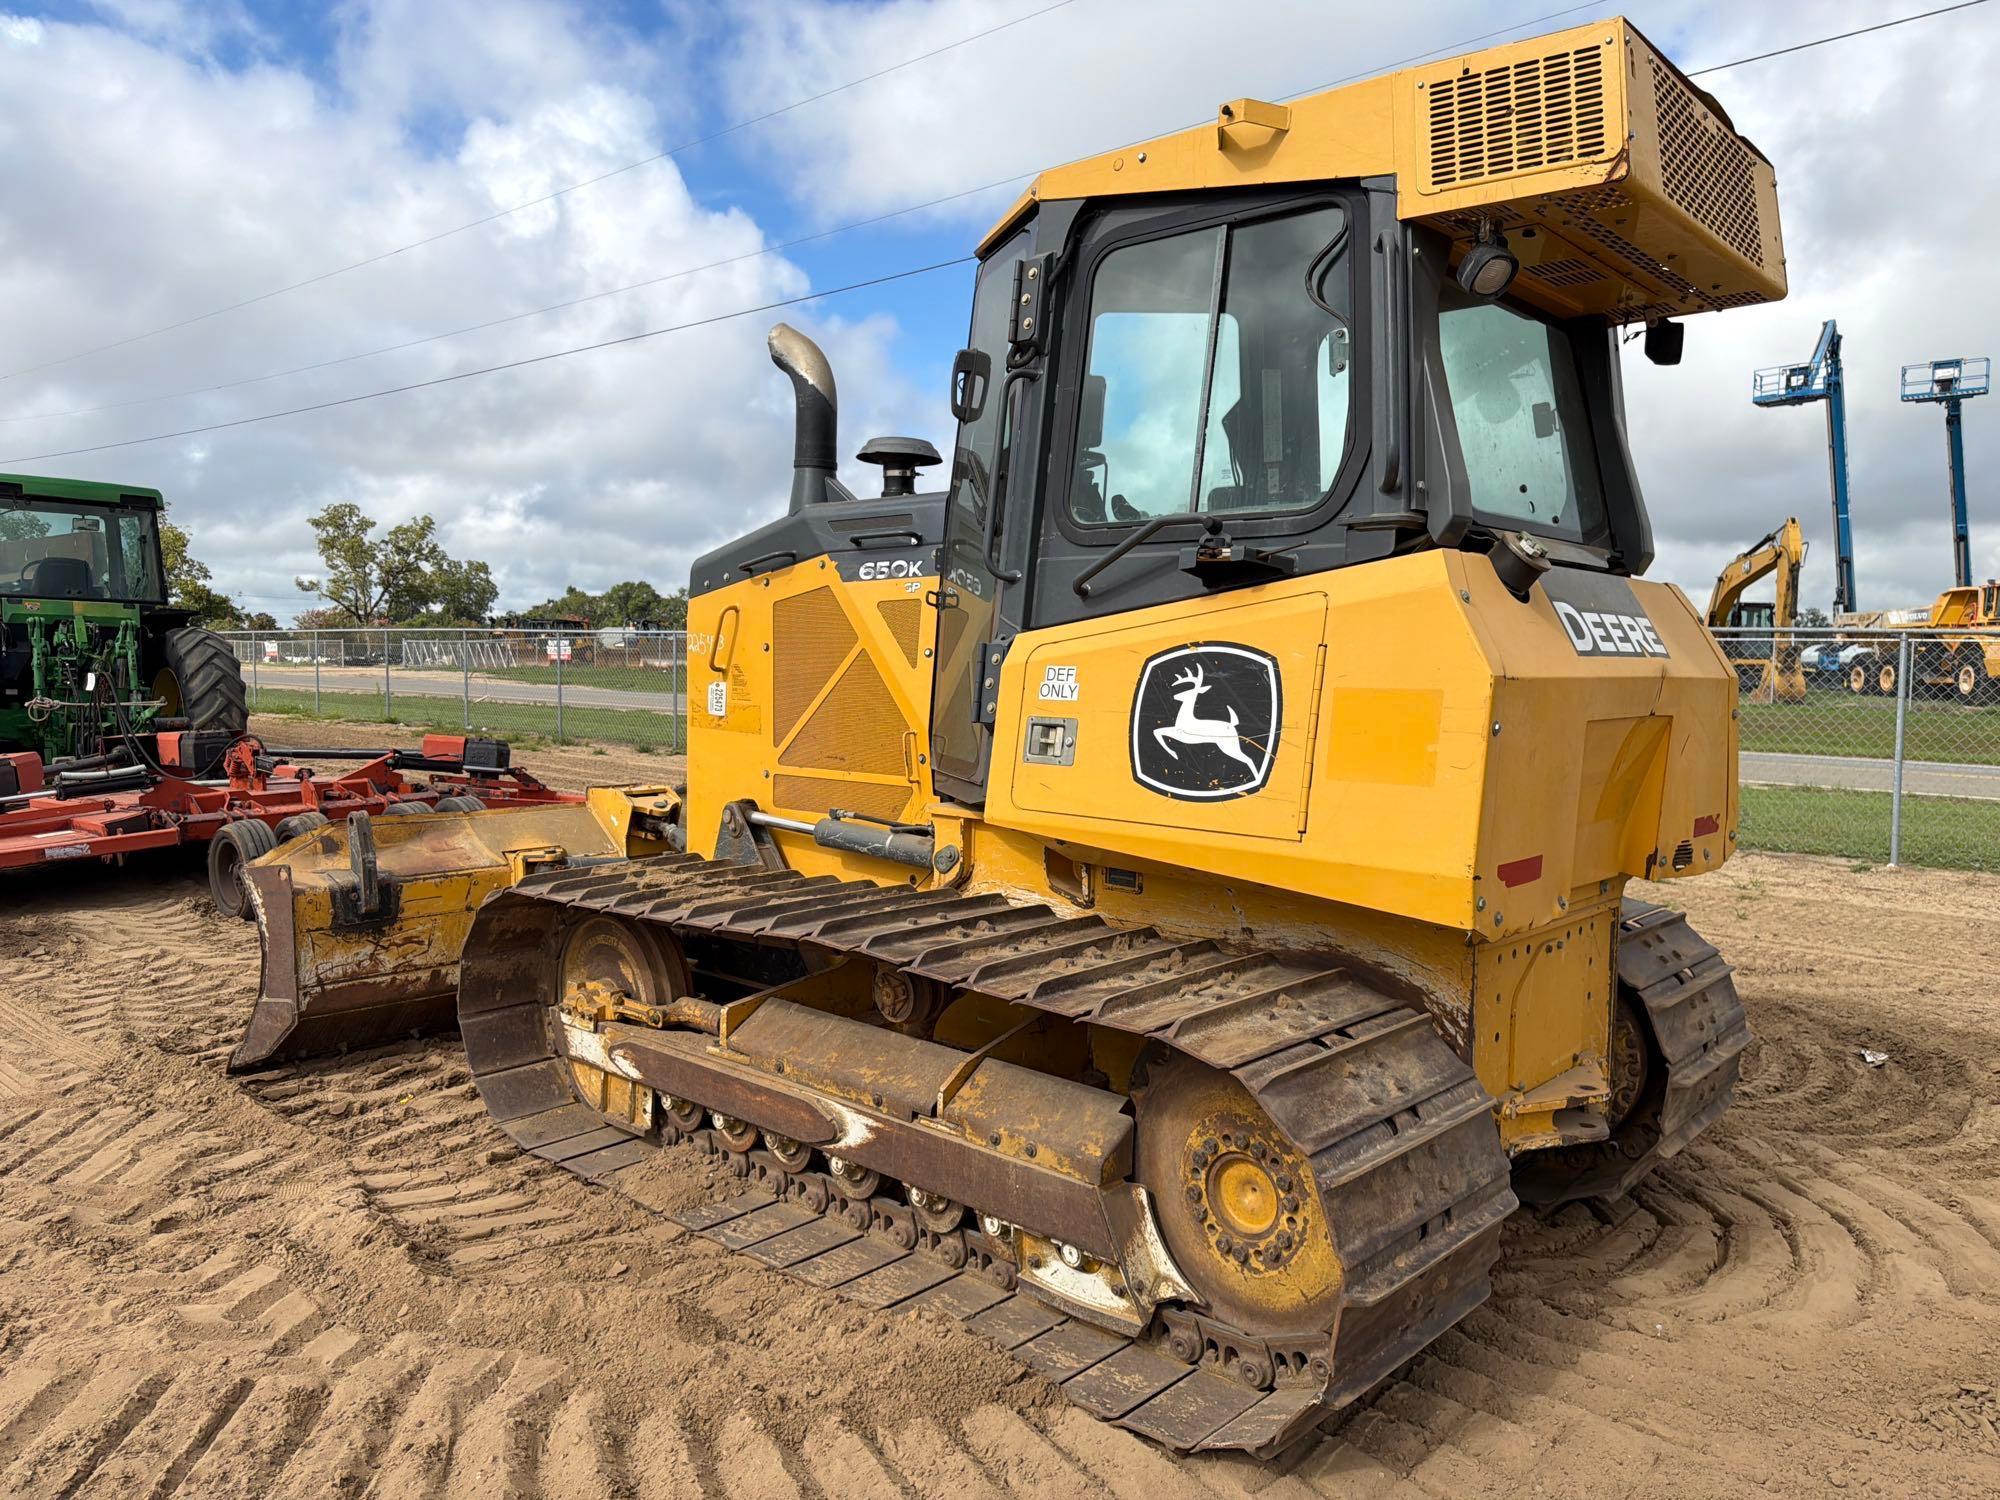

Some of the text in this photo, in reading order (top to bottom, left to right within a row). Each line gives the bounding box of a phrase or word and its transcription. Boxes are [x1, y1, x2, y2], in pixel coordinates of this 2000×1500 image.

[858, 560, 923, 580] 650K
[1552, 601, 1668, 654] DEERE
[687, 632, 725, 655] 22543
[1046, 667, 1075, 682] DEF
[714, 688, 724, 712] 225473
[1040, 683, 1078, 699] ONLY
